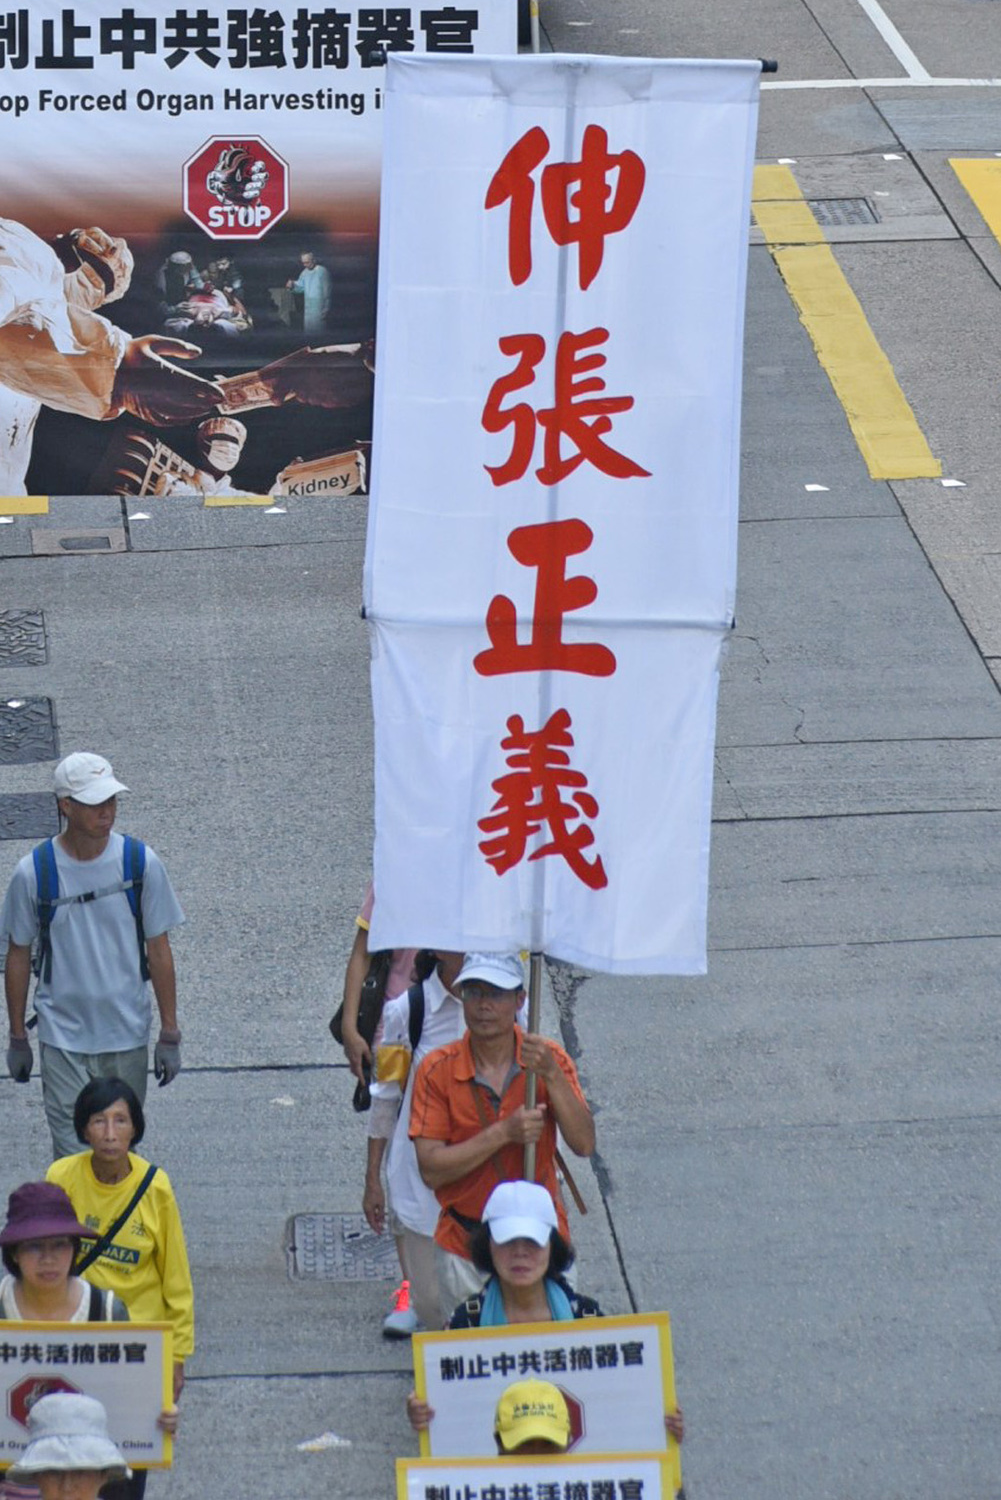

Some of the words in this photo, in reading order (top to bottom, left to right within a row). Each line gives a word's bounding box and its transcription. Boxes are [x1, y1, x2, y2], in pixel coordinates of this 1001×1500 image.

[38, 88, 128, 113] Forced
[136, 89, 216, 118] Organ
[224, 88, 364, 117] Harvesting
[208, 205, 272, 231] STOP
[287, 472, 353, 498] Kidney
[473, 122, 653, 891] 伸張正義
[440, 1341, 645, 1381] 制止中共活摘器官
[122, 1439, 154, 1449] China
